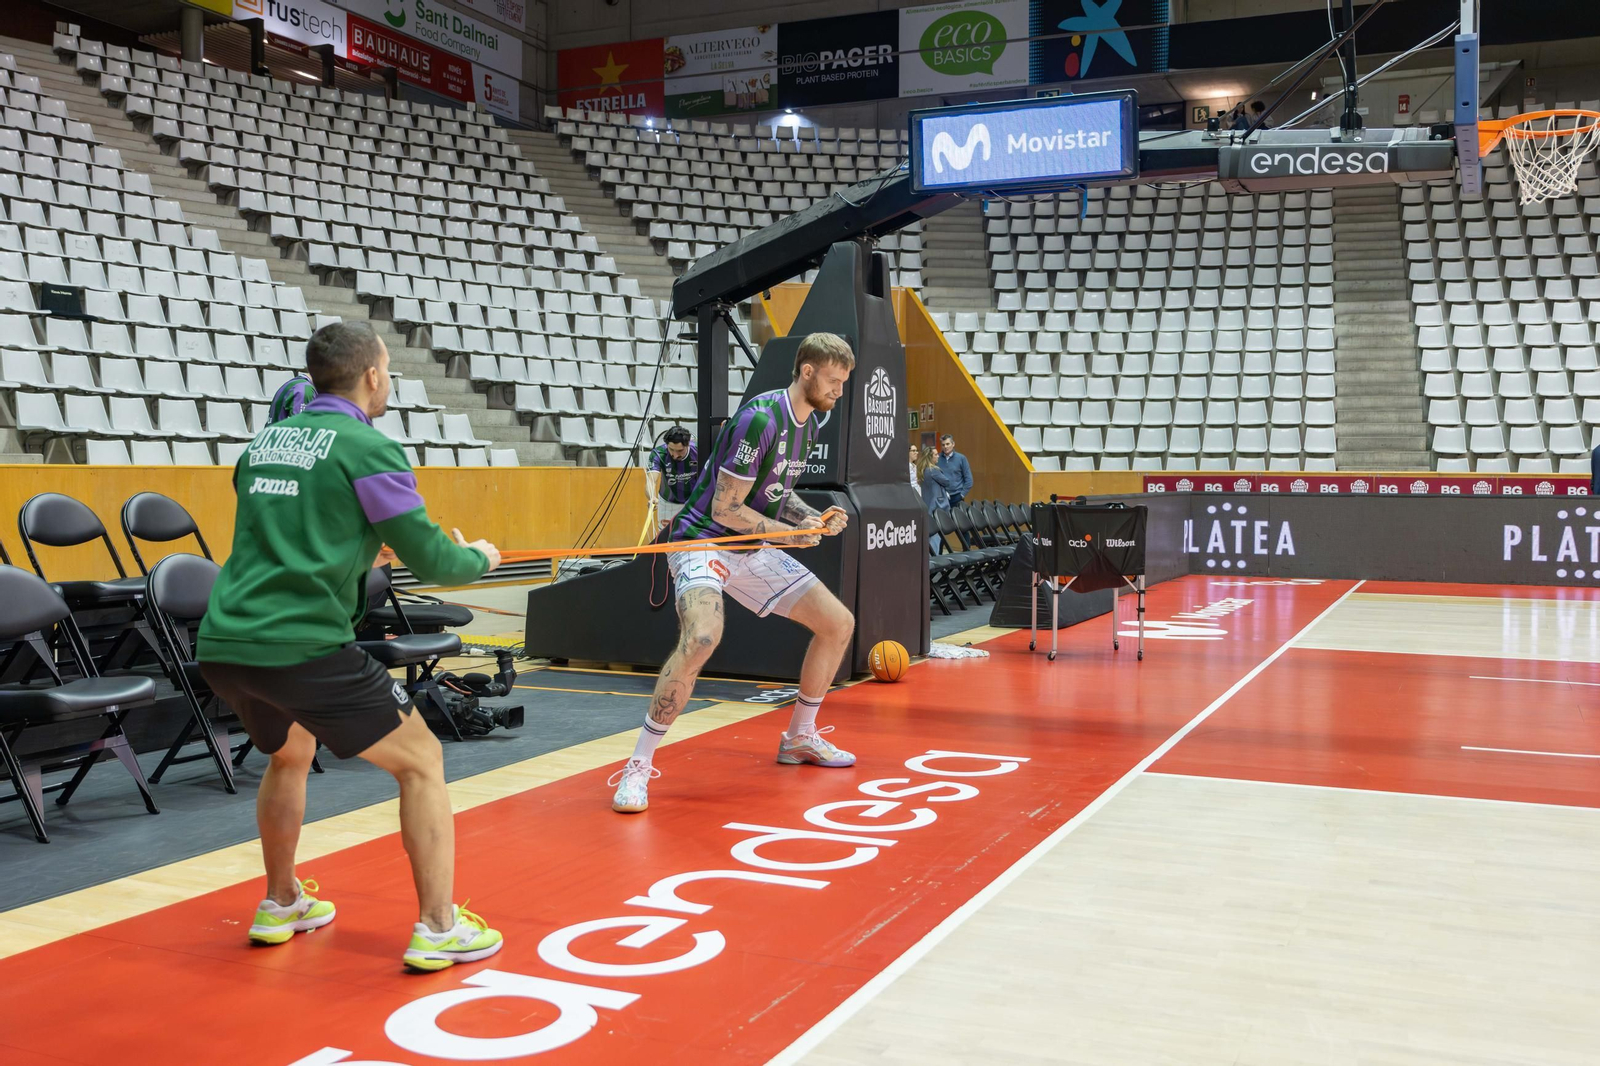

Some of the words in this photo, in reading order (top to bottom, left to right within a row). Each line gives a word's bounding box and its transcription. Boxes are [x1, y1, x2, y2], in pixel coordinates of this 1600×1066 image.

[415, 0, 449, 30] Sant
[453, 15, 499, 51] Dalmai
[933, 20, 992, 49] eco
[354, 28, 430, 71] BAUHAUS
[415, 21, 439, 42] Food
[440, 32, 481, 61] Company
[687, 37, 761, 55] ALTERVEGO
[933, 45, 992, 66] BASICS
[484, 73, 493, 101] 5
[796, 75, 819, 85] PLANT
[821, 73, 846, 83] BASED
[847, 69, 879, 80] PROTEIN
[576, 92, 647, 112] ESTRELLA
[1007, 128, 1112, 154] Movistar
[1250, 146, 1389, 174] endesa
[867, 397, 893, 415] BÀSQUET
[866, 414, 895, 439] GIRONA
[248, 426, 337, 460] UNICAJA
[250, 452, 315, 469] BALONCESTO
[1147, 483, 1165, 492] BG
[1204, 483, 1223, 492] BG
[1260, 483, 1279, 493] BG
[1320, 484, 1339, 493] BG
[1378, 484, 1398, 494] BG
[1440, 485, 1460, 494] BG
[1502, 486, 1523, 495] BG
[1567, 486, 1588, 495] BG
[866, 519, 917, 551] BeGreat
[1068, 538, 1088, 548] acb
[1105, 538, 1136, 548] Wilson
[1183, 519, 1296, 556] PLATEA
[536, 749, 1031, 977] endesa
